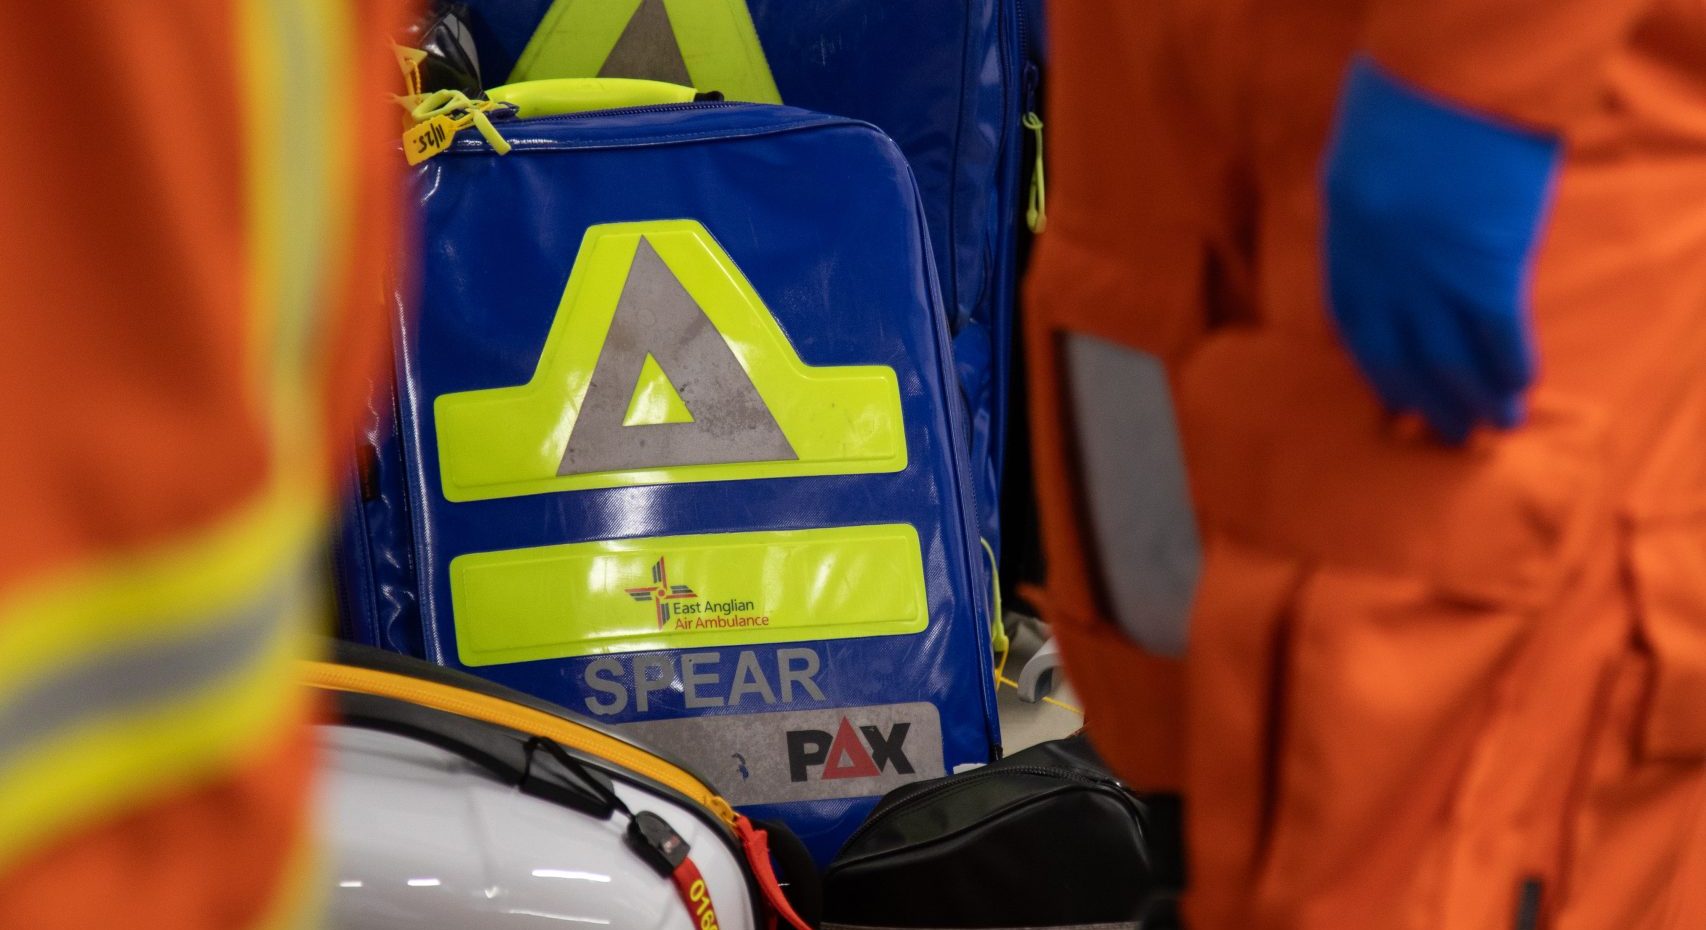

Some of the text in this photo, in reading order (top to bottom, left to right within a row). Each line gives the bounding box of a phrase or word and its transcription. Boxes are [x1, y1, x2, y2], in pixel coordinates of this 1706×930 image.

[673, 599, 755, 616] East Anglian
[675, 614, 769, 631] Air Ambulance
[584, 647, 826, 716] SPEAR
[786, 715, 916, 783] PAX
